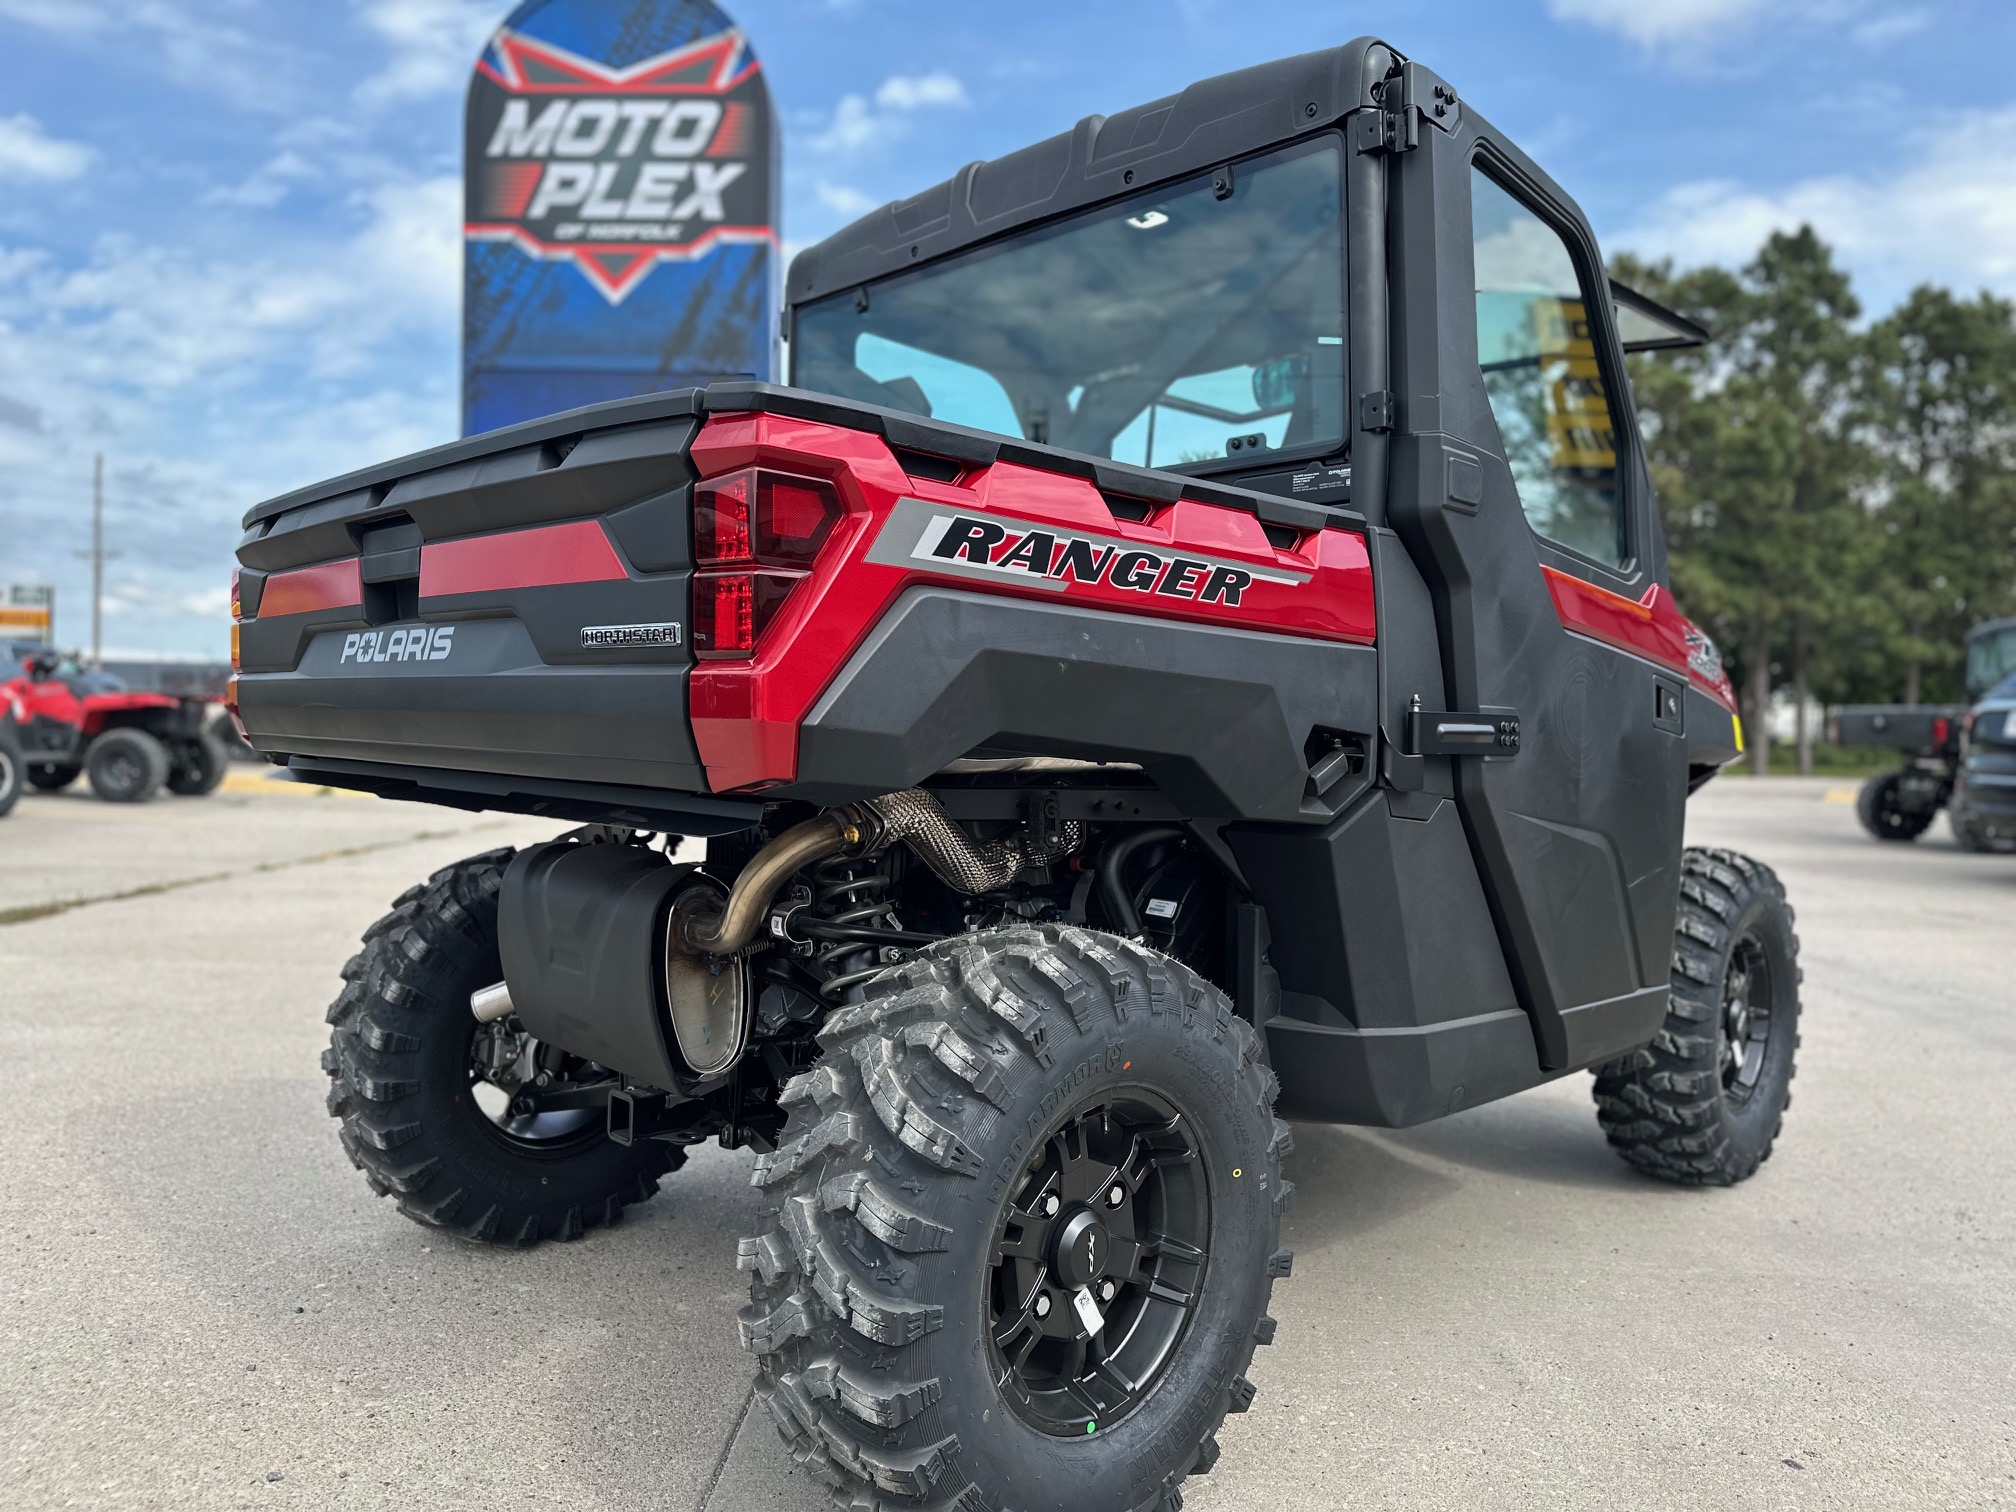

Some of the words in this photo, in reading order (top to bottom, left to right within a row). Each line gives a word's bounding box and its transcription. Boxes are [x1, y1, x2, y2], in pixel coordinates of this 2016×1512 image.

[486, 99, 722, 157] MOTO
[527, 162, 746, 220] PLEX
[931, 515, 1252, 606] RANGER
[340, 626, 455, 664] POLARIS
[584, 627, 673, 645] NORTHSTAR
[1026, 1053, 1103, 1139] ARMOR
[1087, 1230, 1096, 1274] XP
[1126, 1318, 1247, 1489] X-TERRAIN
